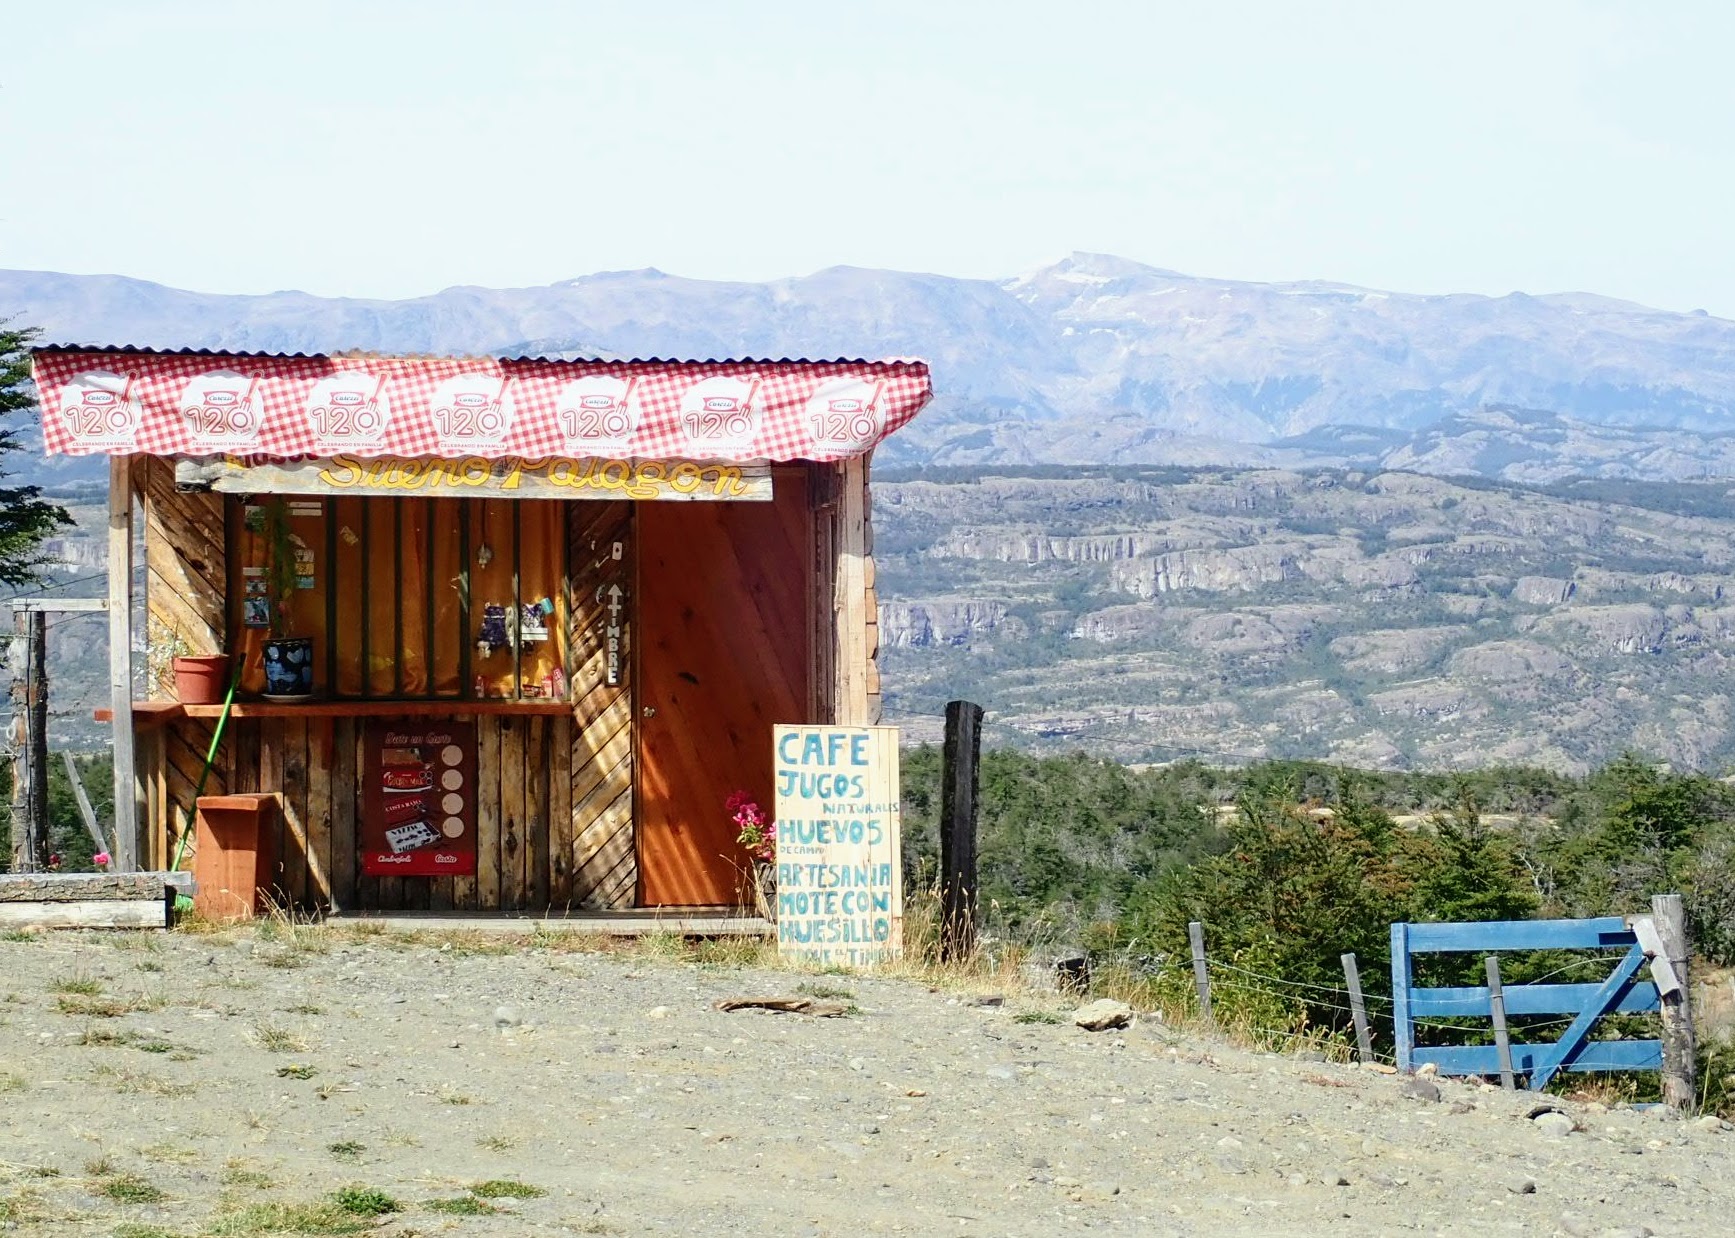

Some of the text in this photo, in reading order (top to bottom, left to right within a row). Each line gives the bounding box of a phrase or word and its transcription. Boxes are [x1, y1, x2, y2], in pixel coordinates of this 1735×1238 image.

[65, 405, 134, 436] 120
[185, 405, 256, 436] 120
[310, 405, 382, 437] 120
[434, 406, 506, 438] 120
[560, 408, 632, 440] 120
[683, 410, 753, 439] 120
[810, 413, 878, 442] 120
[607, 604, 621, 684] TIMBRE
[777, 769, 865, 799] JUGOS
[822, 801, 900, 815] NATURALES
[778, 819, 883, 846] HUEVOS
[779, 845, 792, 855] DE
[778, 890, 890, 916] MOTE CON
